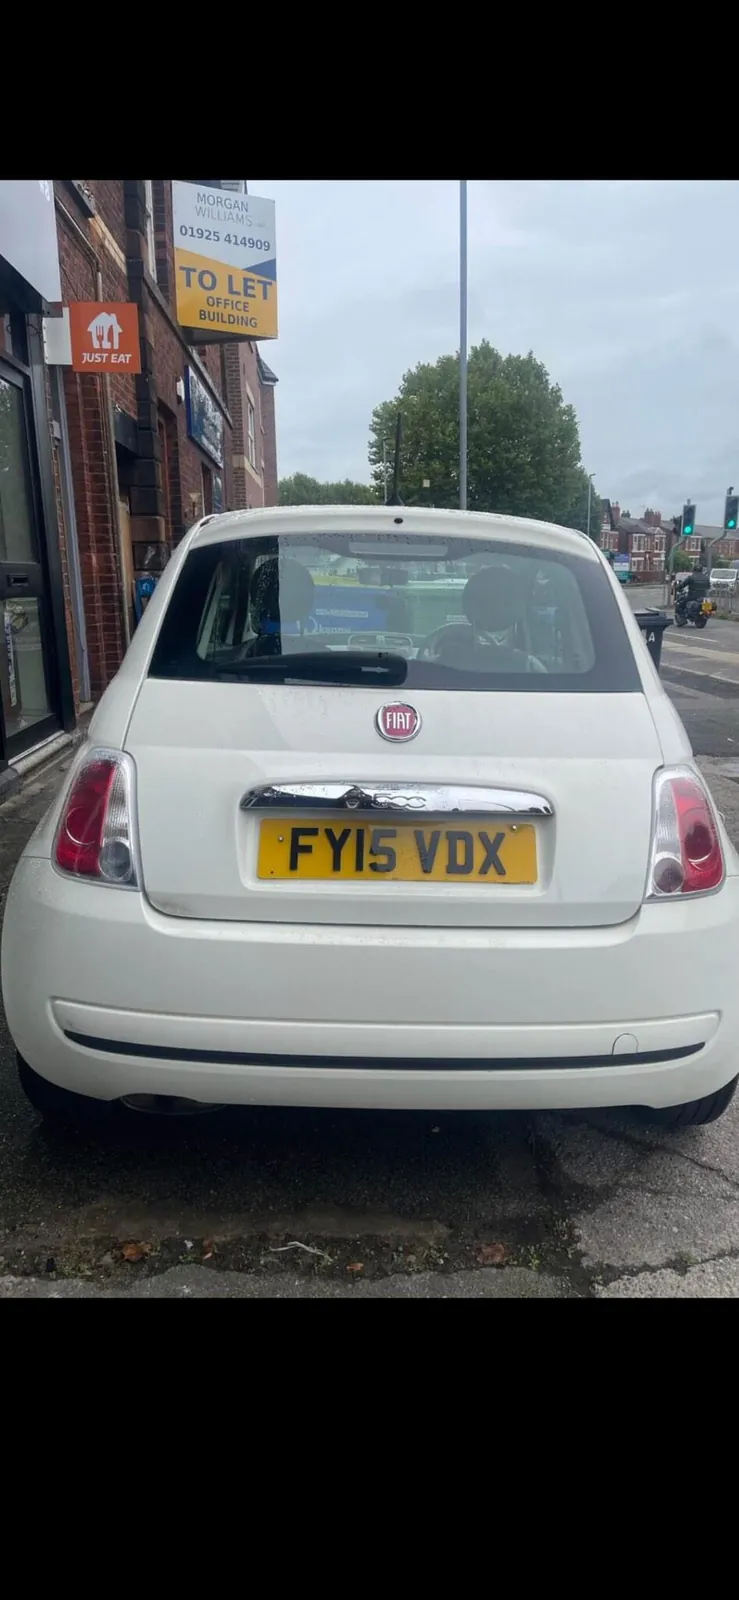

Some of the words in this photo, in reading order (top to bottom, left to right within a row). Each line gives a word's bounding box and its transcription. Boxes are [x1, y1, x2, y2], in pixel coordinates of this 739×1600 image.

[196, 192, 249, 213] MORGAN
[195, 204, 253, 227] WILLIAMS
[179, 225, 220, 242] 01925
[224, 233, 271, 252] 414909
[179, 266, 217, 291] TO
[228, 274, 273, 300] LET
[206, 296, 250, 312] OFFICE
[199, 309, 258, 328] BUILDING
[81, 353, 108, 364] JUST
[111, 354, 132, 364] EAT
[386, 712, 411, 730] FIAT
[289, 827, 397, 873] FY15
[413, 830, 506, 875] VDX
